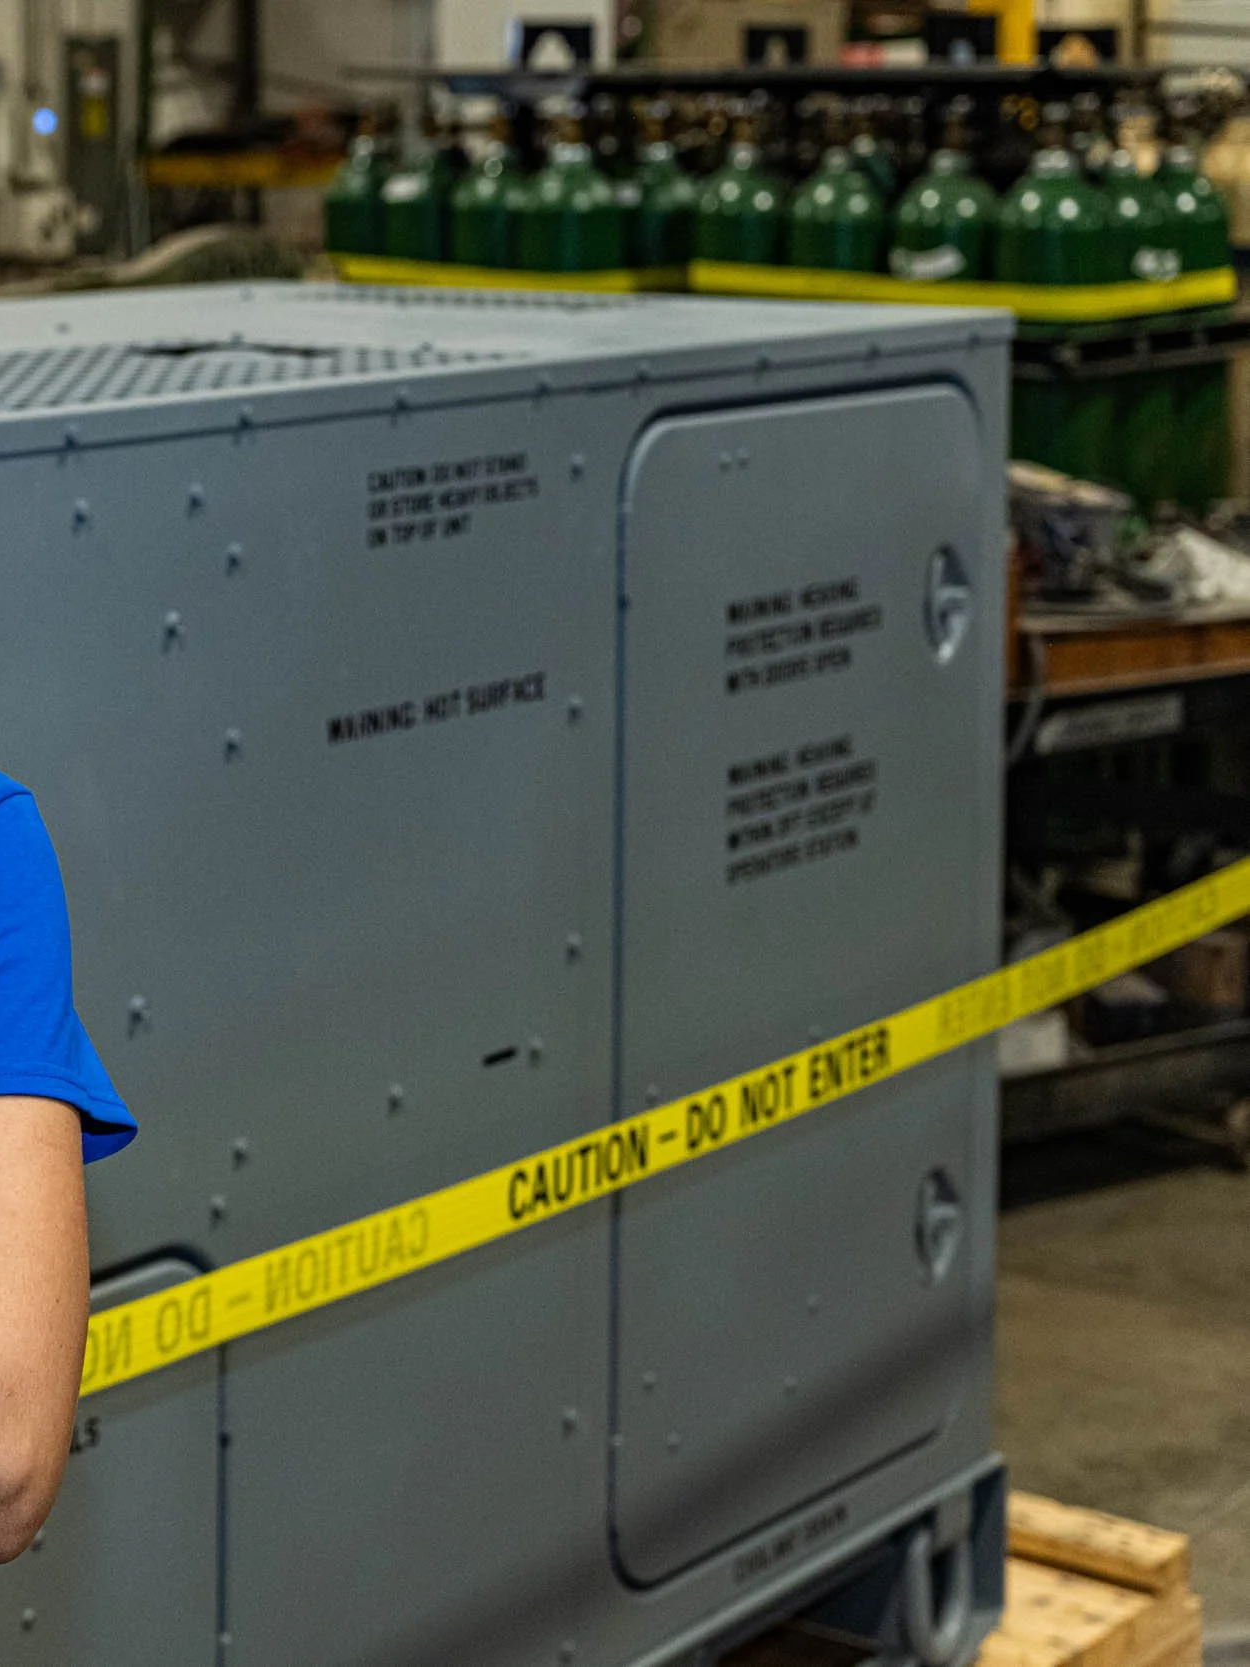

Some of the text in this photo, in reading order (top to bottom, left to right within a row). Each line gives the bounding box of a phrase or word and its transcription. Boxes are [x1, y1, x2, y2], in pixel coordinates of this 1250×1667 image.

[326, 670, 547, 747] WARNING HOT SURFACE
[506, 1123, 649, 1220] CAUTION
[686, 1093, 728, 1151] DO
[739, 1064, 798, 1128] NOT
[807, 1026, 891, 1101] ENTER
